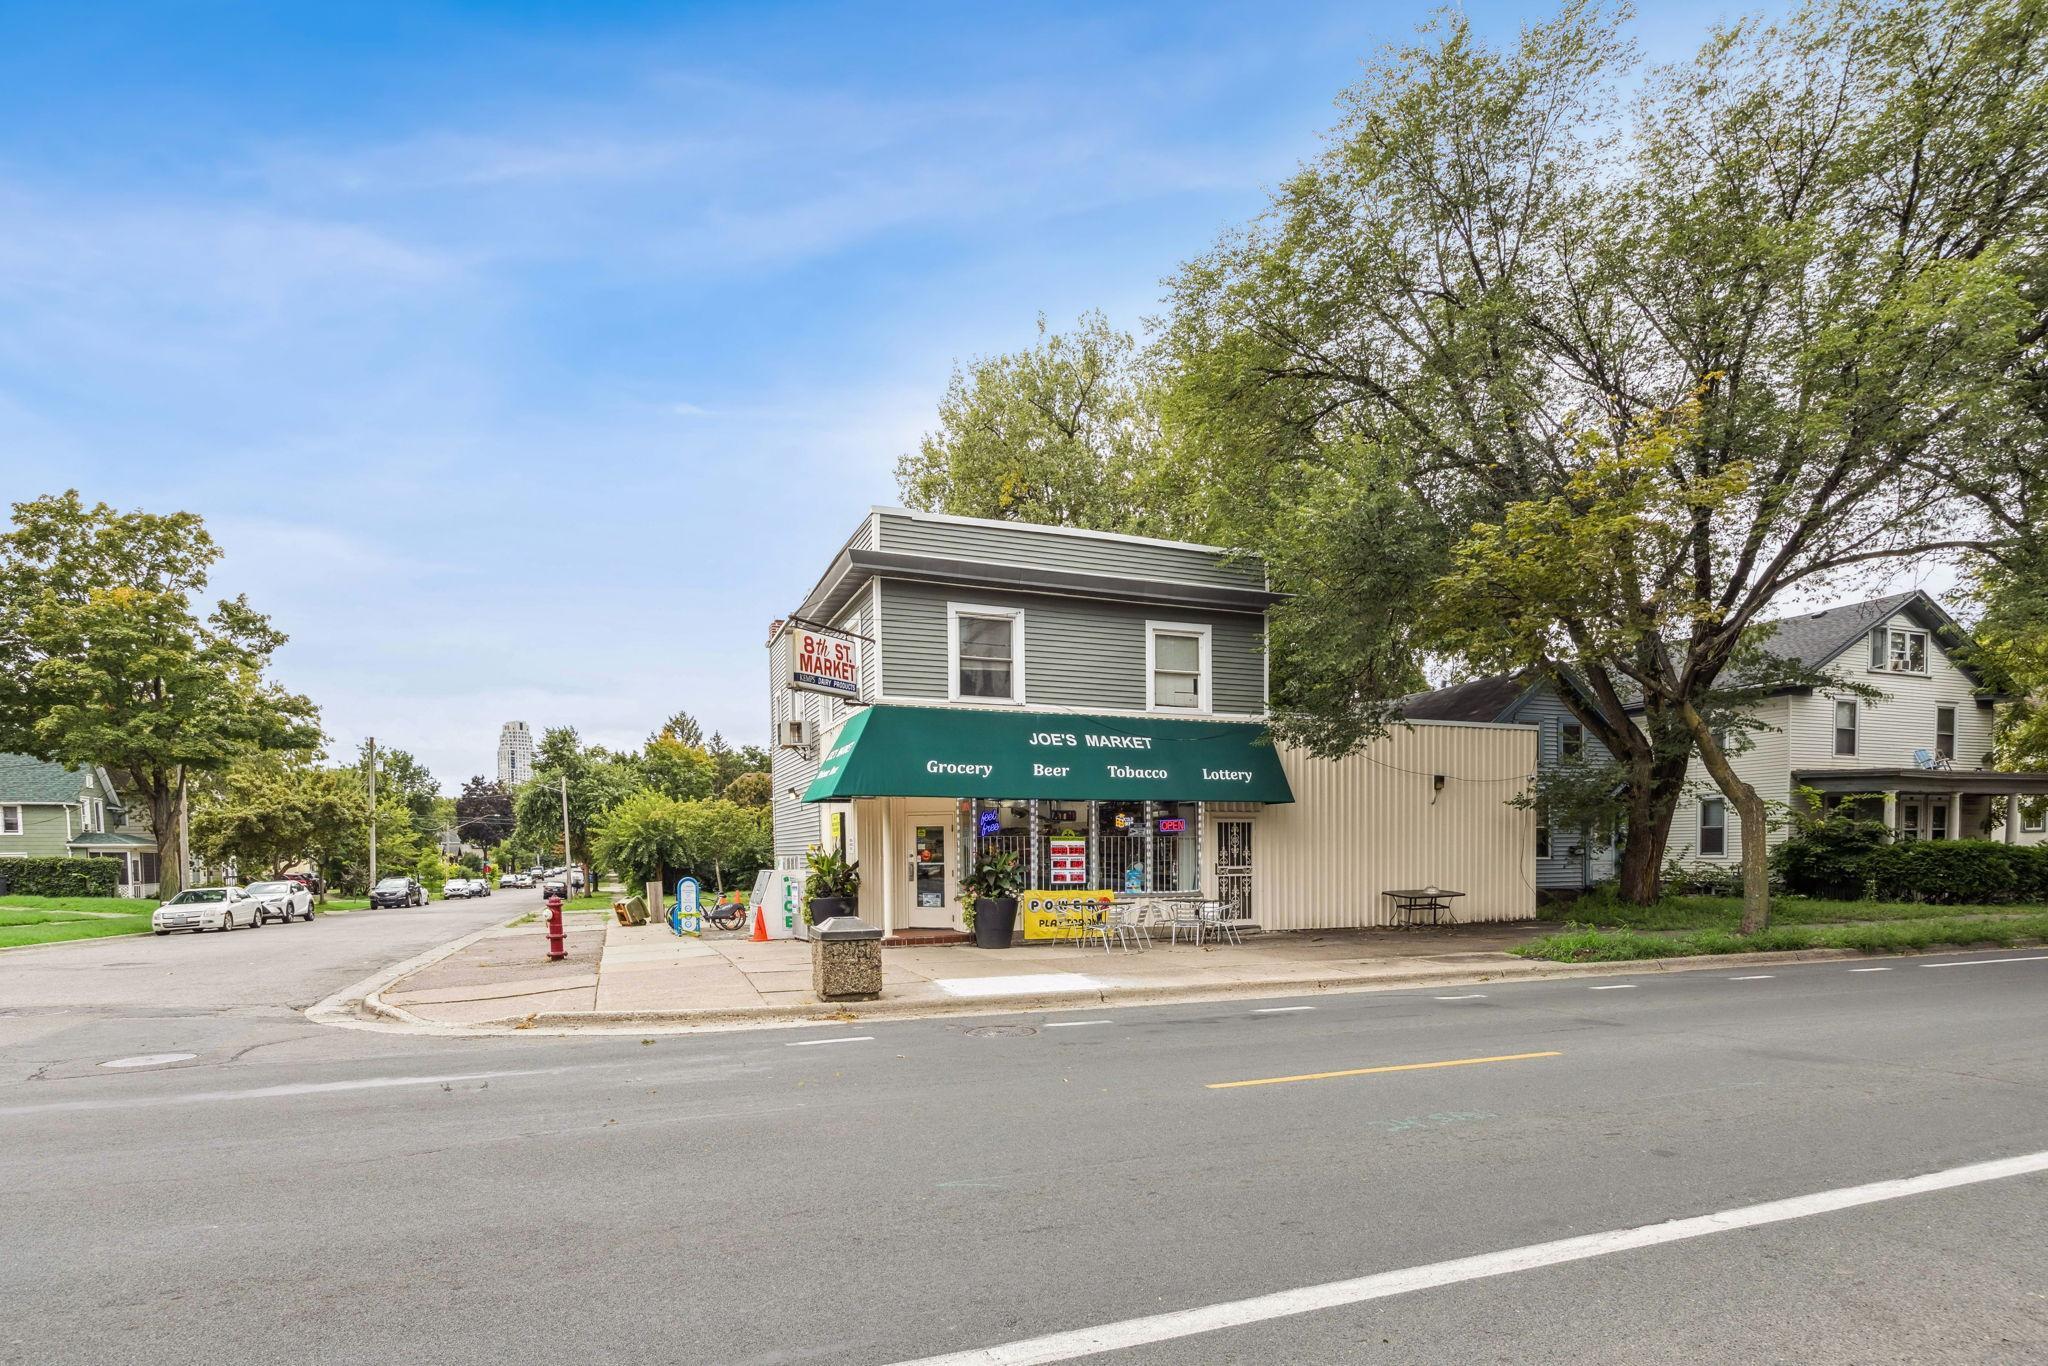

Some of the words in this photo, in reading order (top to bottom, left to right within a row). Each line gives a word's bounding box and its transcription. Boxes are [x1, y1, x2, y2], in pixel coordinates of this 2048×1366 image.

[804, 636, 829, 657] 8th
[835, 643, 852, 663] ST.
[800, 653, 855, 681] MARKET
[818, 677, 832, 687] DAIRY
[833, 681, 856, 691] PRODUCTS
[1029, 733, 1078, 746] JOE'S
[1085, 734, 1152, 749] MARKET
[926, 760, 993, 778] Grocery
[1033, 763, 1070, 777] Beer
[1107, 765, 1168, 779] Tobacco
[1202, 768, 1253, 783] Lottery
[980, 809, 997, 825] feel
[982, 821, 1000, 836] free
[1161, 820, 1185, 831] OPEN
